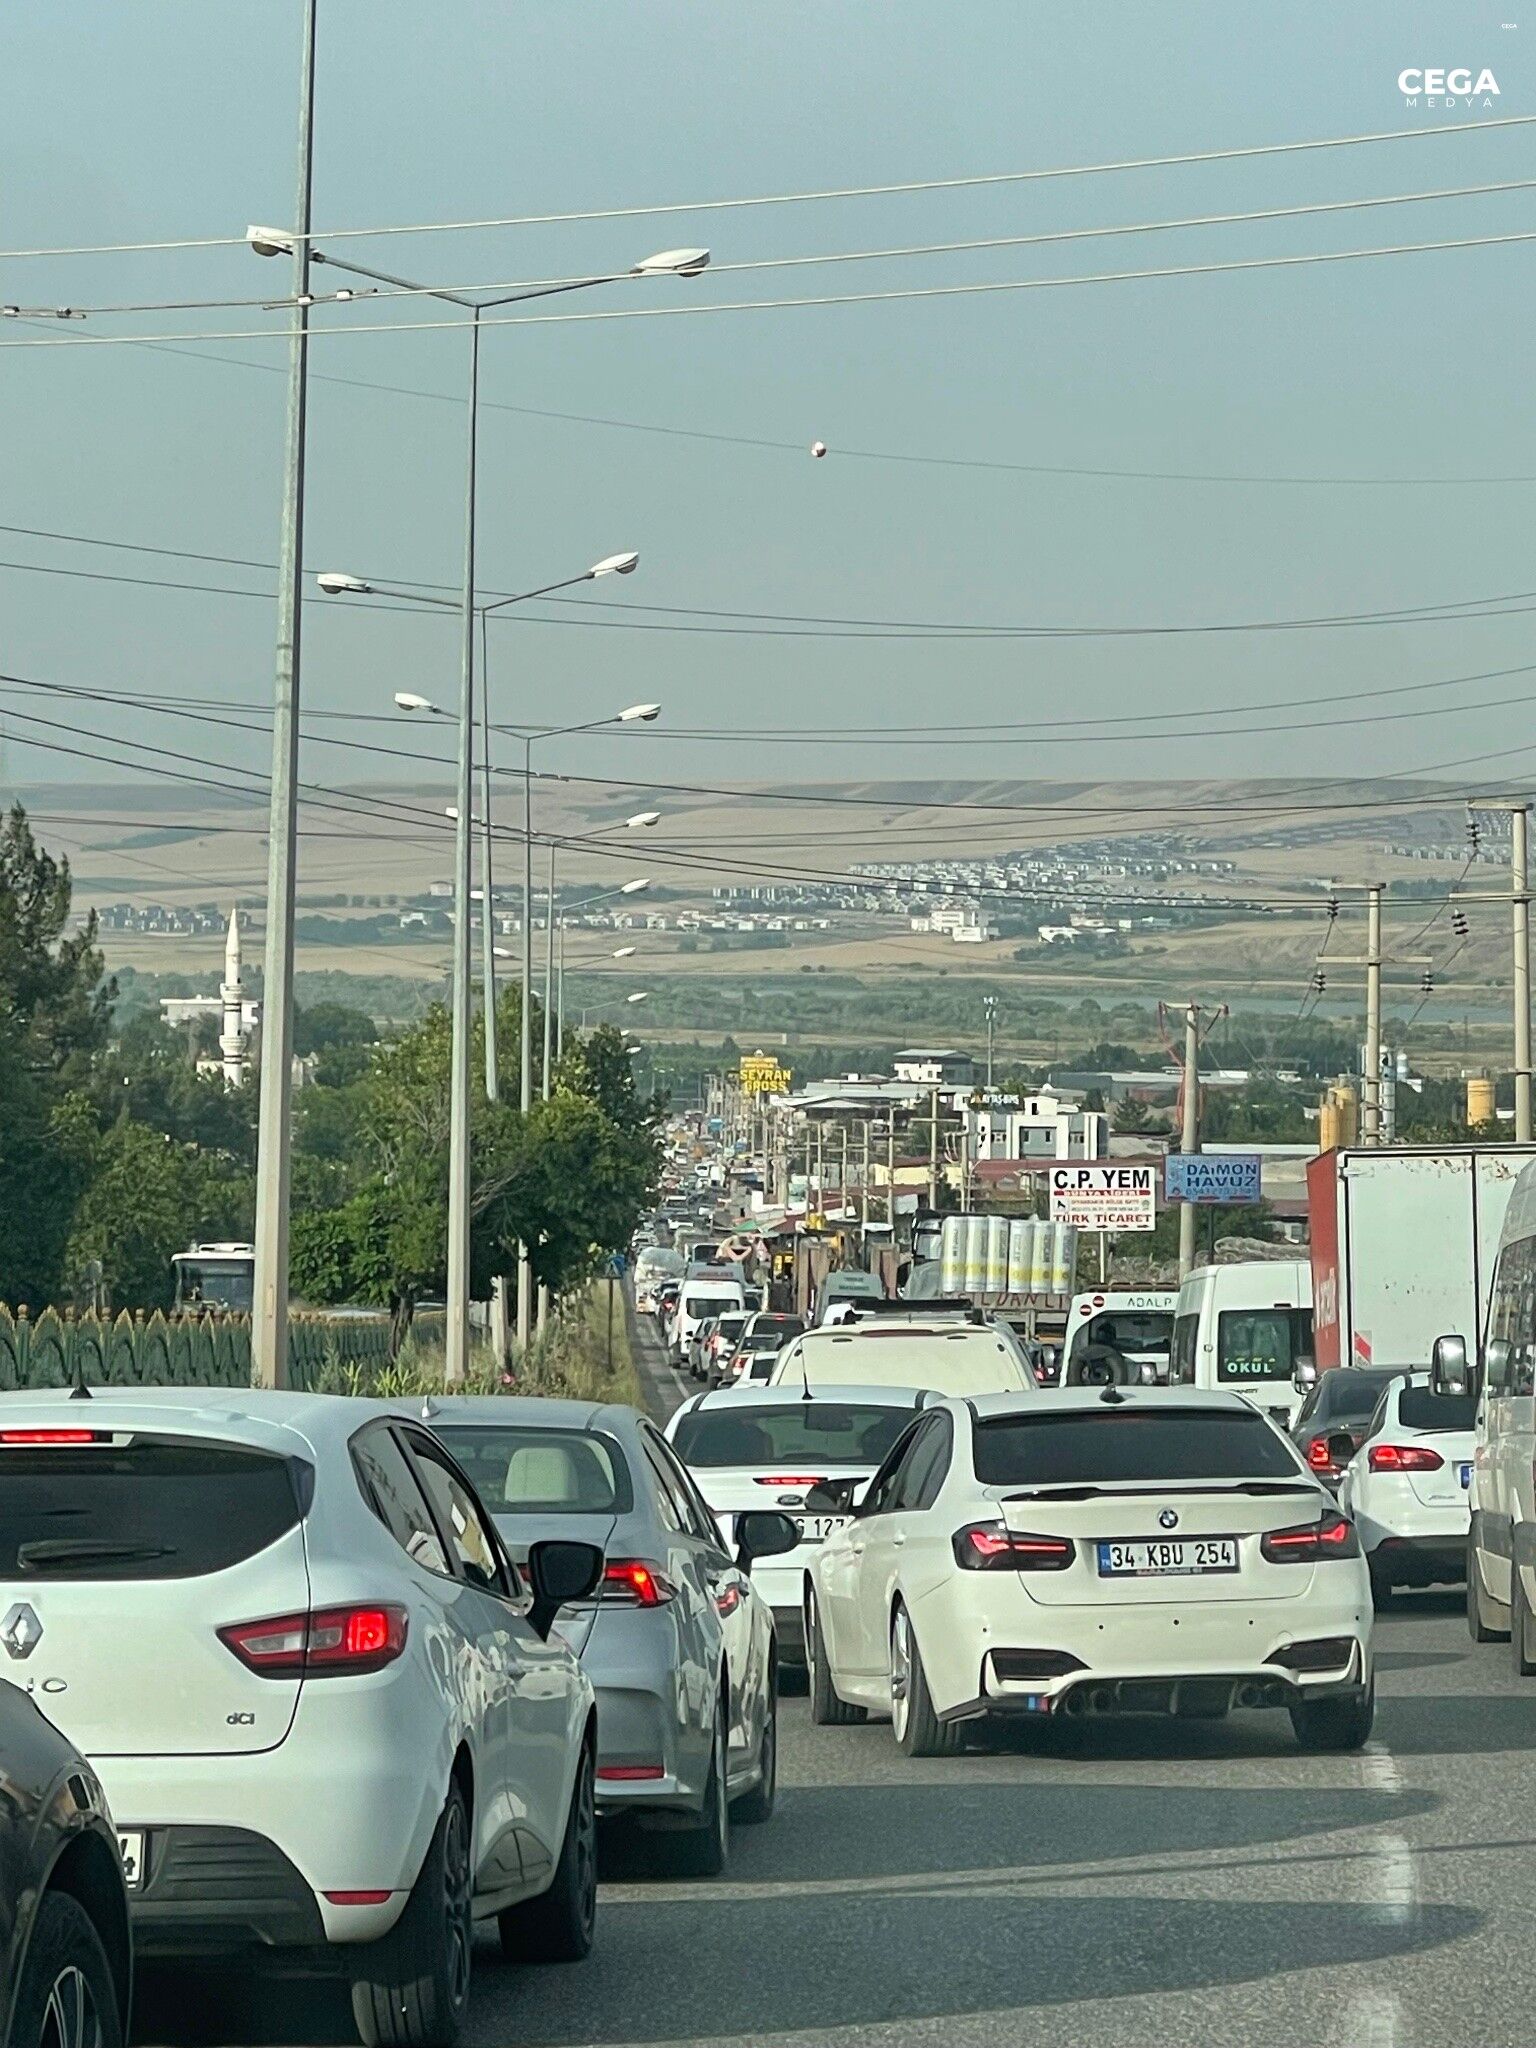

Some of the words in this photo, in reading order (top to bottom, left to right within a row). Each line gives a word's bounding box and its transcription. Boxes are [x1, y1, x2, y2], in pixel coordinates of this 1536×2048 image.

[740, 1069, 791, 1081] SEYRAN
[744, 1080, 787, 1092] GROSS
[1054, 1169, 1094, 1189] C.P.
[1101, 1169, 1150, 1189] YEM
[1187, 1176, 1256, 1187] HAVUZ
[1053, 1211, 1090, 1223] TÜRK
[1096, 1211, 1152, 1223] TİCARET
[1227, 1362, 1272, 1373] OKUL
[1111, 1546, 1135, 1568] 34
[1146, 1544, 1184, 1567] KBU
[1194, 1542, 1232, 1565] 254
